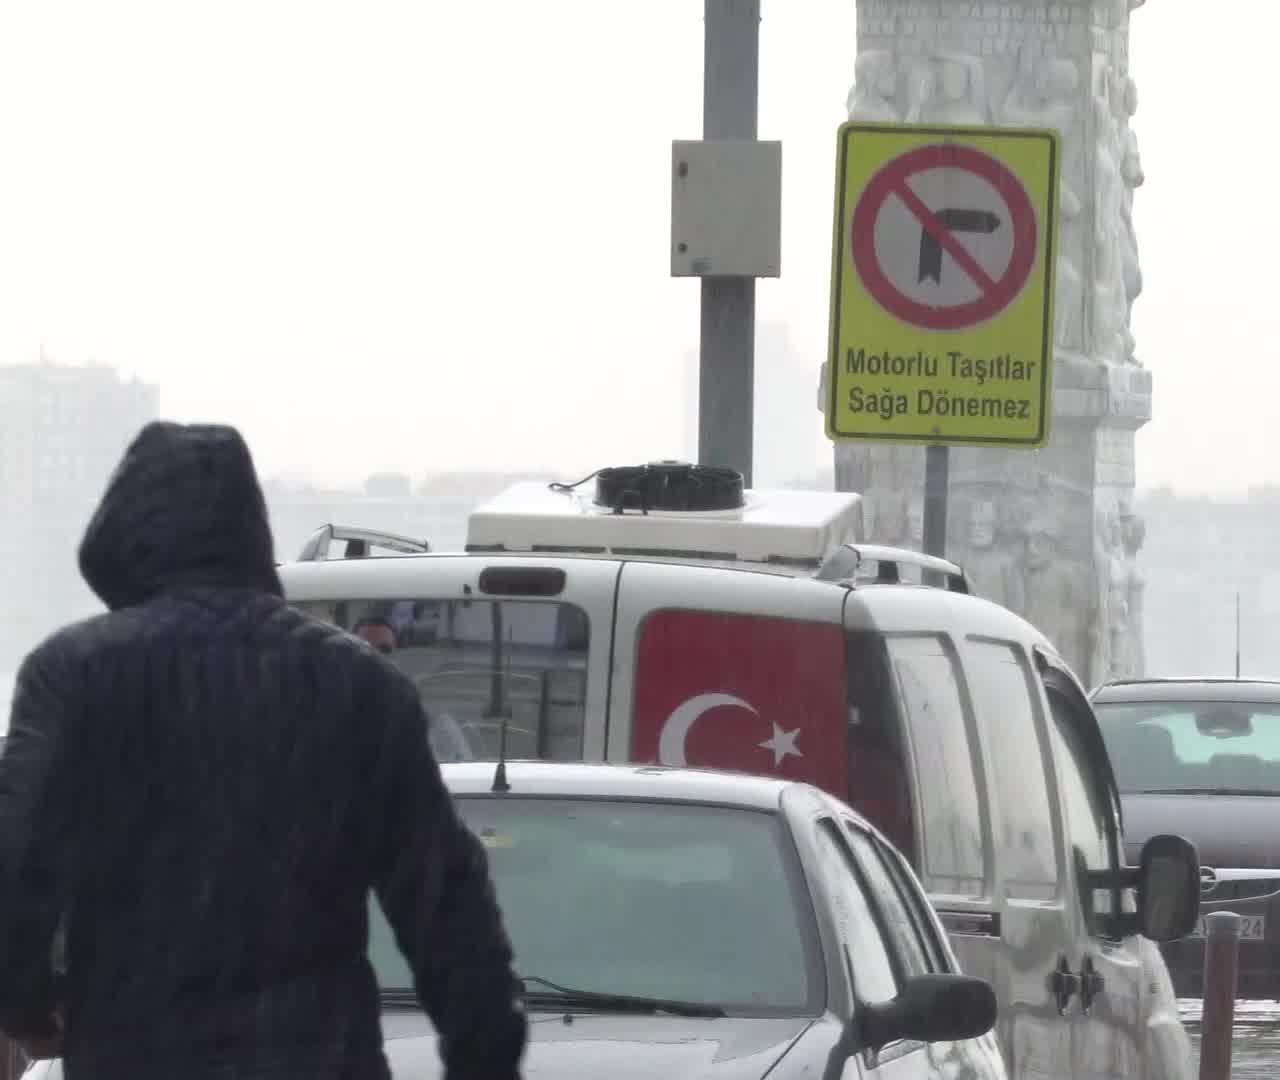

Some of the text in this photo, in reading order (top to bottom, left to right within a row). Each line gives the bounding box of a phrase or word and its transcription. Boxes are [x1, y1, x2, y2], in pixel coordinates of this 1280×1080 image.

[846, 348, 1036, 384] Motorlu Taşıtlar
[848, 387, 1031, 420] Sağa Dönemez
